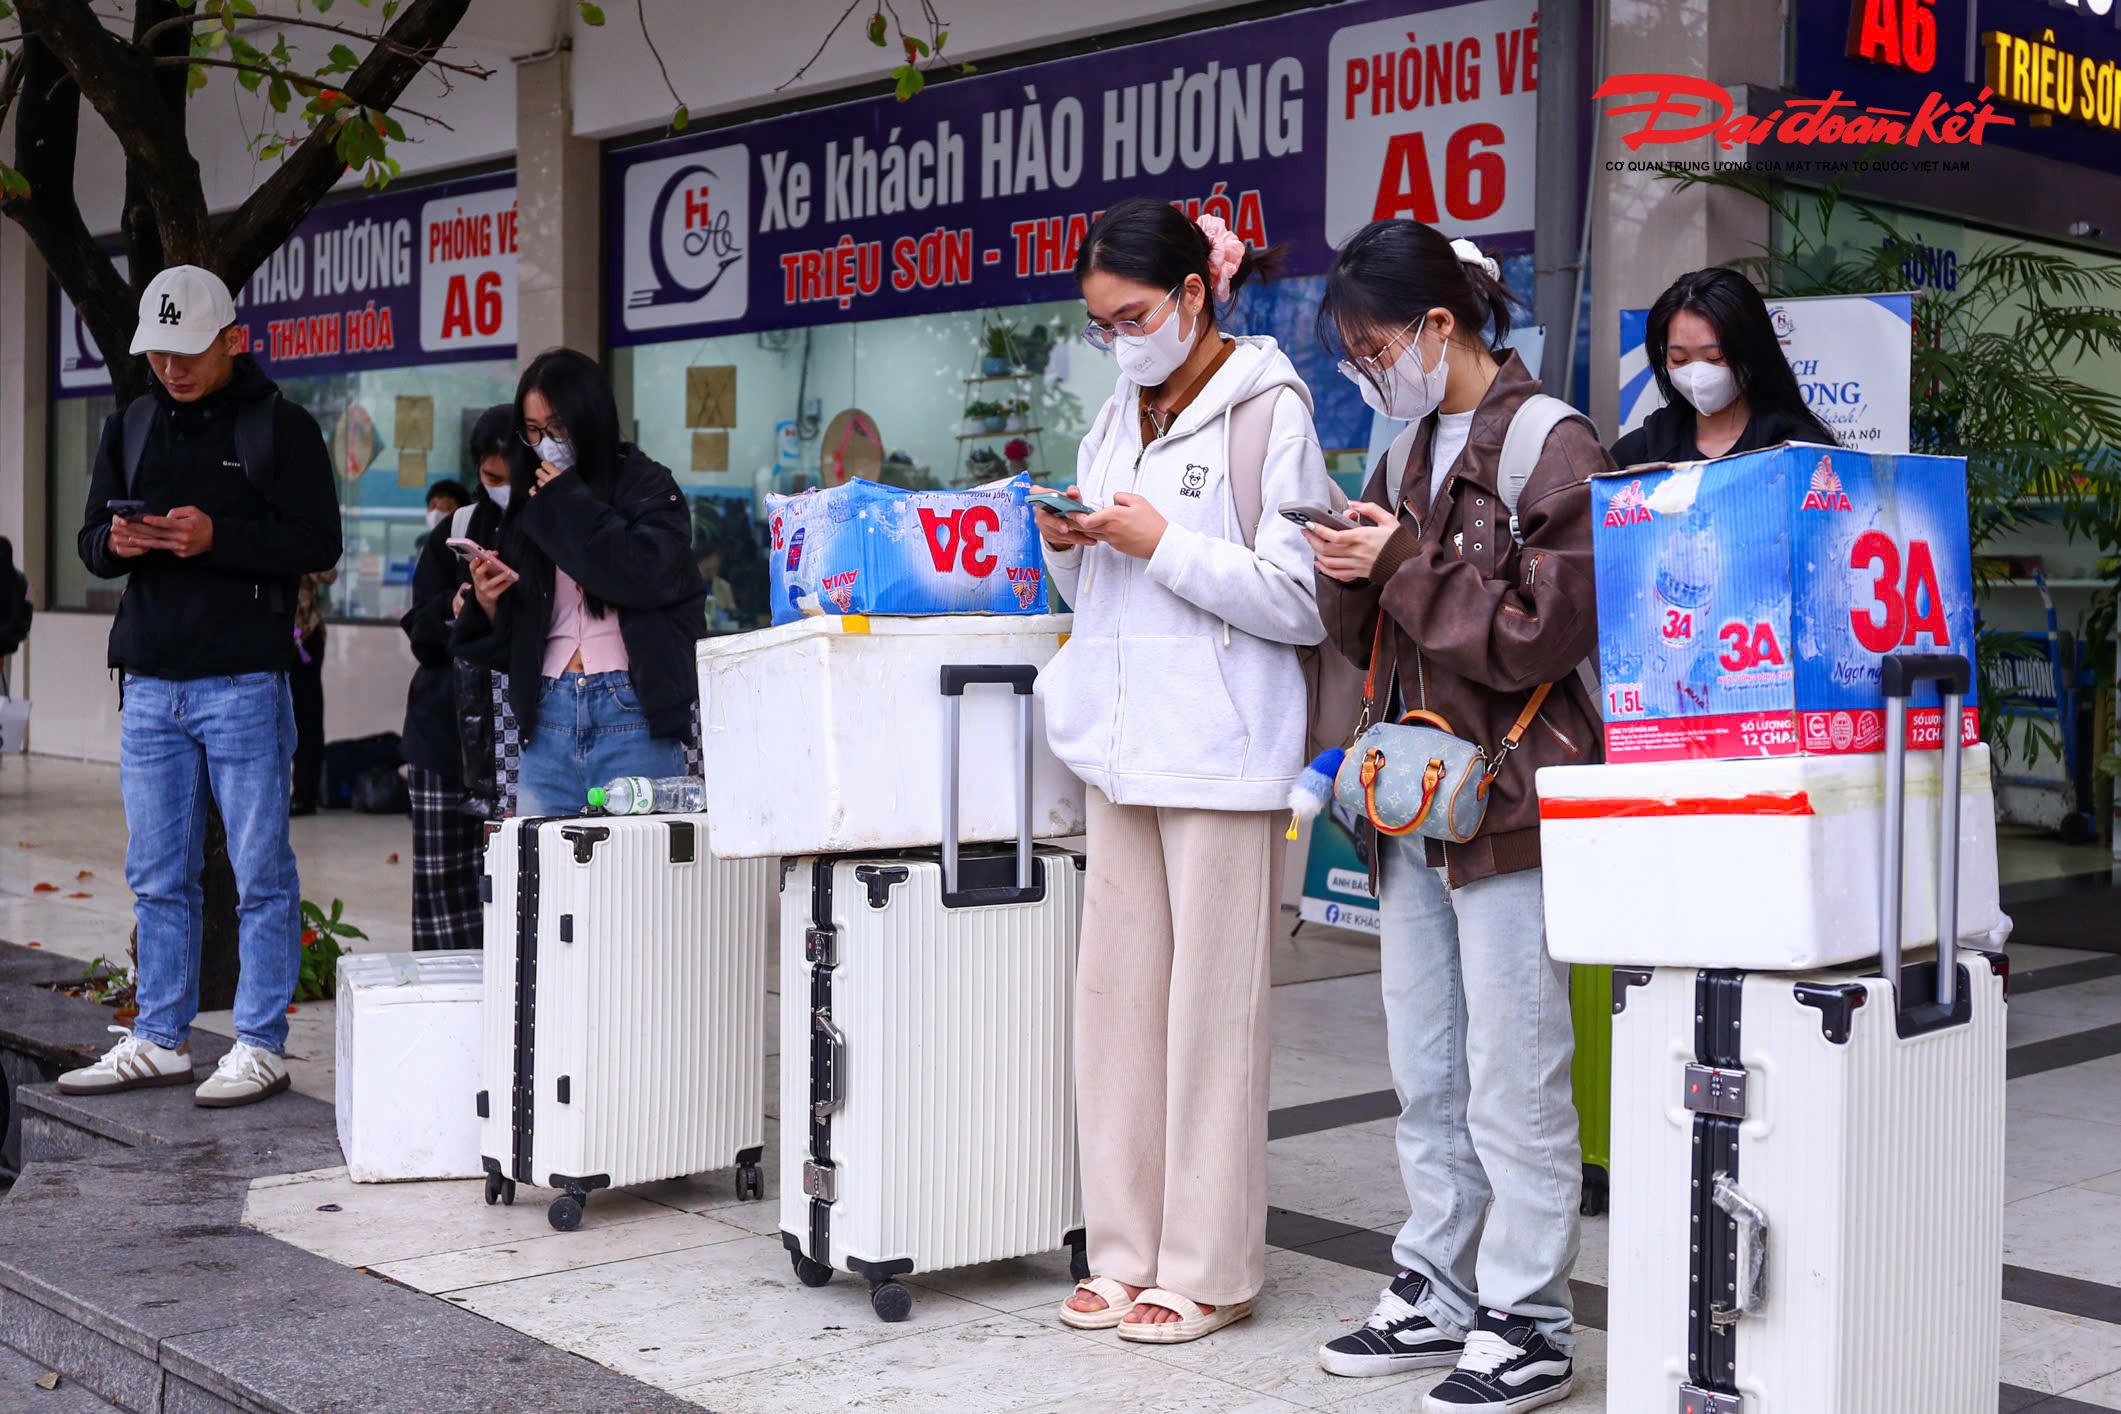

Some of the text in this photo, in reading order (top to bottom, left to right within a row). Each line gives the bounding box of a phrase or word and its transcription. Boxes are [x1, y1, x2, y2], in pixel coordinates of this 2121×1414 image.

[1345, 31, 1480, 120] PHÒNG
[759, 57, 1304, 233] Xe khách HÀO HƯƠNG
[1371, 122, 1506, 224] A6
[429, 207, 492, 264] PHÒNG
[313, 217, 411, 297] HƯƠNG
[780, 238, 882, 309] TRIỆU
[892, 227, 973, 290] SƠN
[1011, 211, 1105, 277] THA
[158, 294, 181, 325] LA
[440, 270, 503, 340] A6
[268, 311, 341, 362] THANH
[346, 299, 394, 354] HÓA
[1799, 382, 1861, 405] ƠNG
[1180, 488, 1201, 499] BEAR
[1801, 490, 1853, 513] AVIA
[1604, 504, 1654, 529] AVIA
[917, 506, 1000, 579] 3A
[821, 570, 858, 591] AVIA
[1006, 567, 1042, 582] AVIA
[1849, 529, 1949, 654] 3A
[1662, 609, 1692, 639] 3A
[1719, 622, 1785, 672] 3A
[1833, 661, 1865, 685] Ngọt
[1609, 690, 1644, 715] 1,5L
[1741, 719, 1755, 732] SỐ
[1913, 727, 1940, 742] 12 CH
[1961, 718, 1977, 743] ,5L
[1742, 733, 1760, 746] 12
[1341, 912, 1380, 928] XE KHÁC
